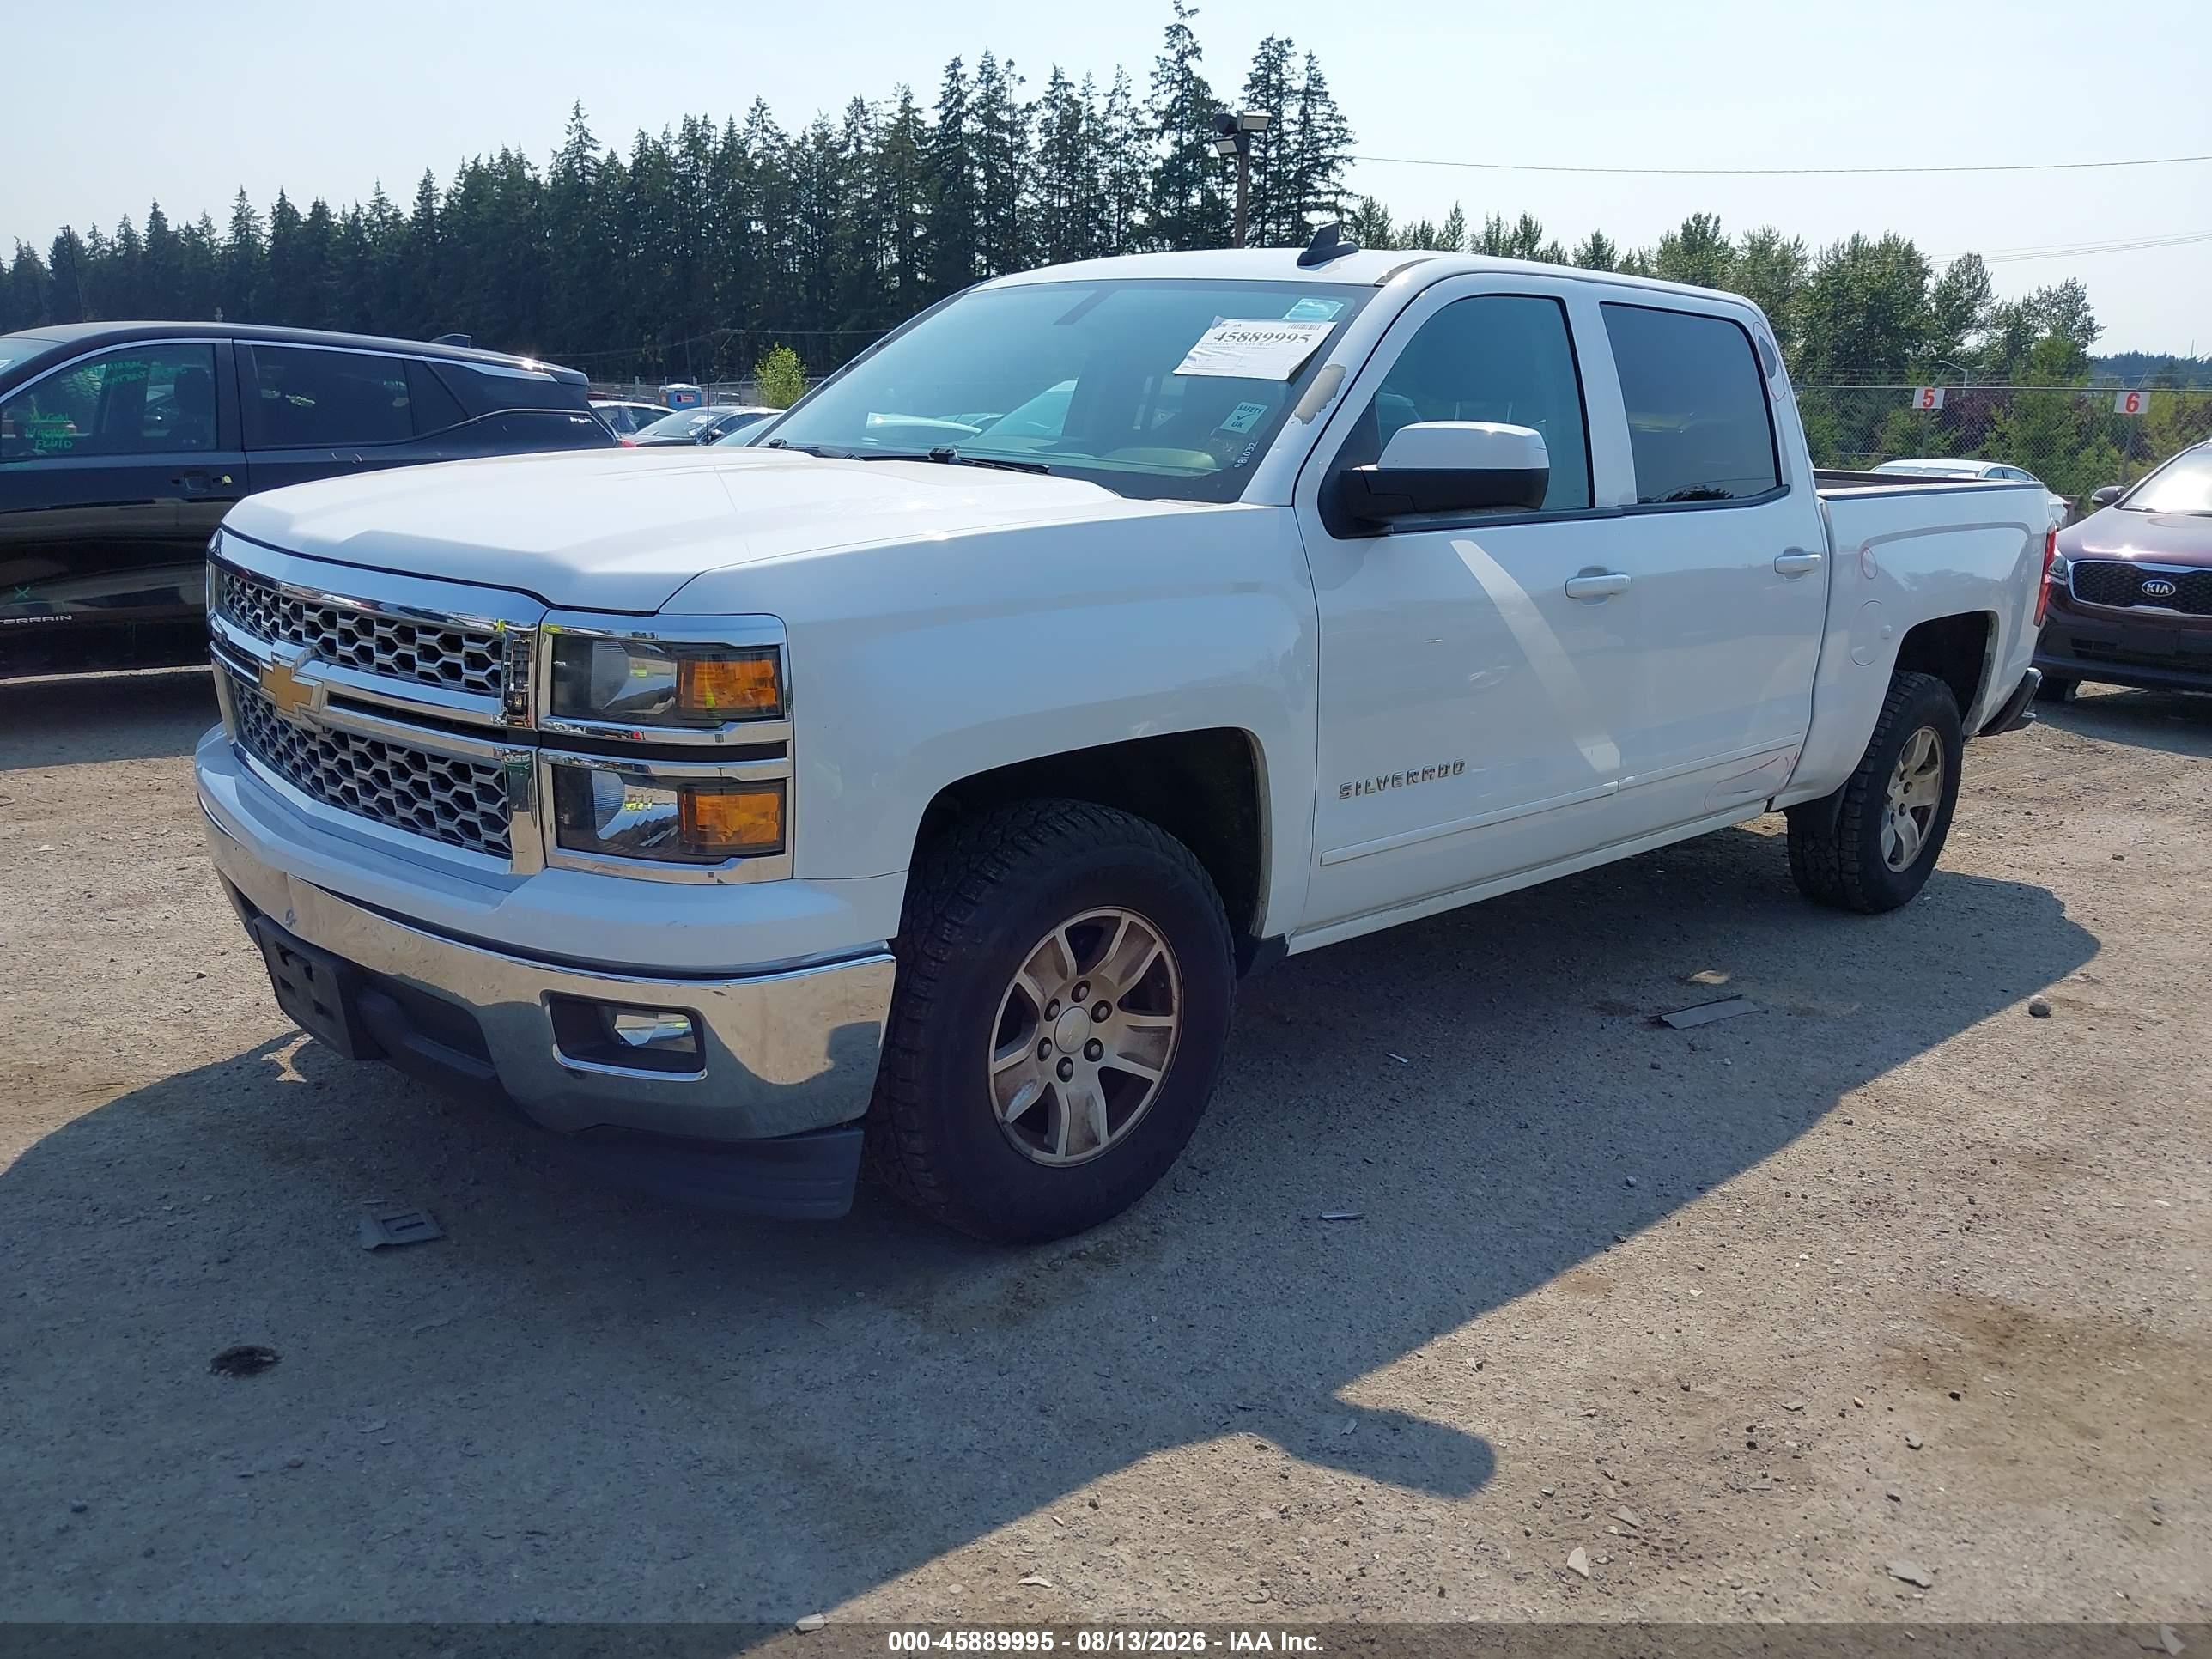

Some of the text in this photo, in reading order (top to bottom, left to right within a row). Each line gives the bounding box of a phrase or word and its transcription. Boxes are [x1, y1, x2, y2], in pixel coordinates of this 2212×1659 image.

[1213, 331, 1313, 344] 45889995
[1923, 388, 1936, 408] 5
[2125, 392, 2140, 413] 6
[1237, 404, 1264, 413] SAFETY
[1234, 441, 1259, 468] 981032
[2147, 583, 2170, 594] KIA
[1339, 759, 1466, 800] SILVERADO
